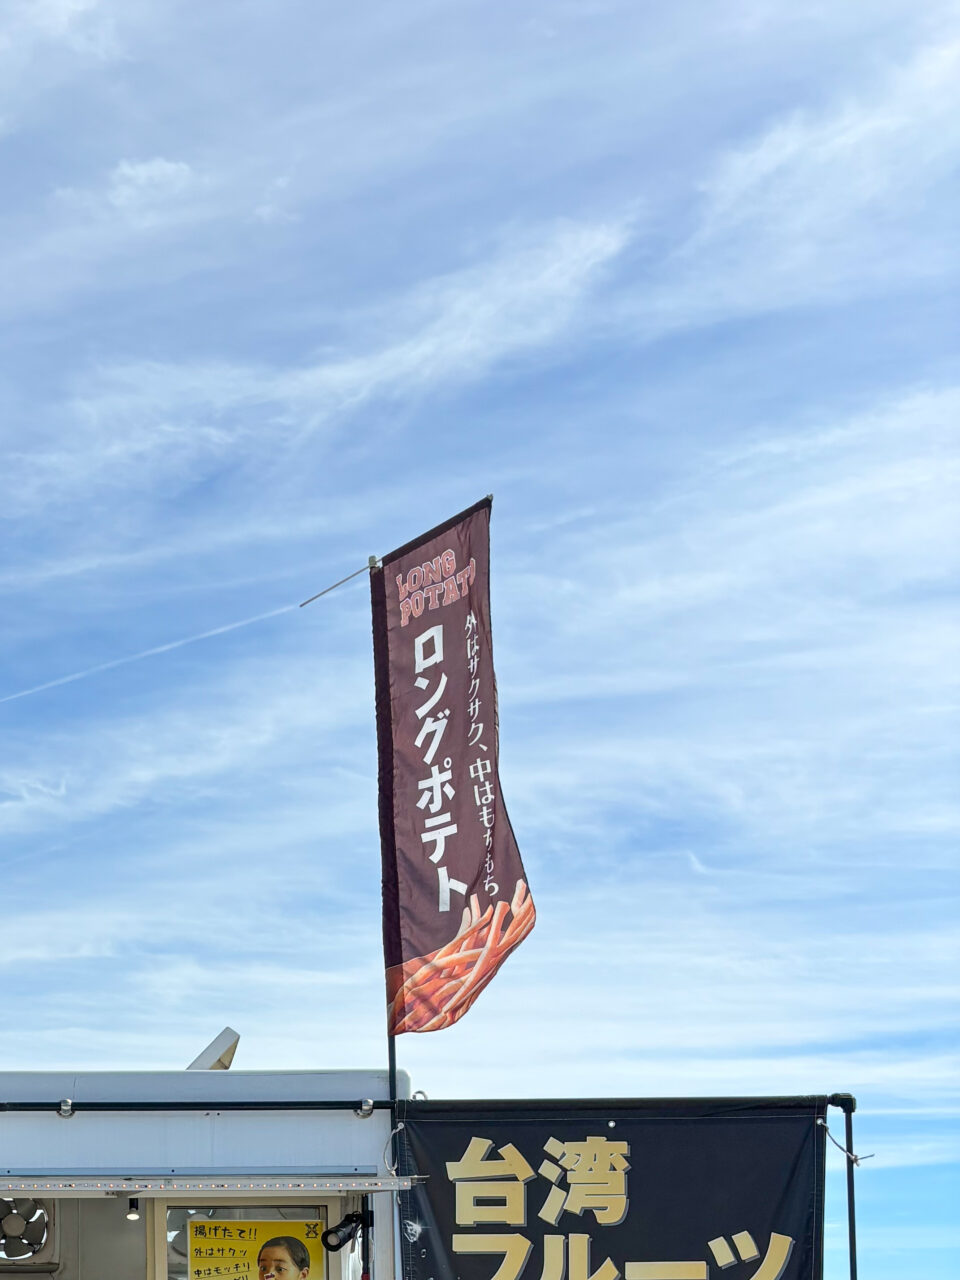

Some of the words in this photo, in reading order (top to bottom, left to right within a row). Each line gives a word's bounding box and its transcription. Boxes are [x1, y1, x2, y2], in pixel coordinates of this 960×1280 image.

[396, 549, 456, 601] LONG
[414, 624, 468, 912] ロングポテト
[445, 1136, 630, 1226] 台湾
